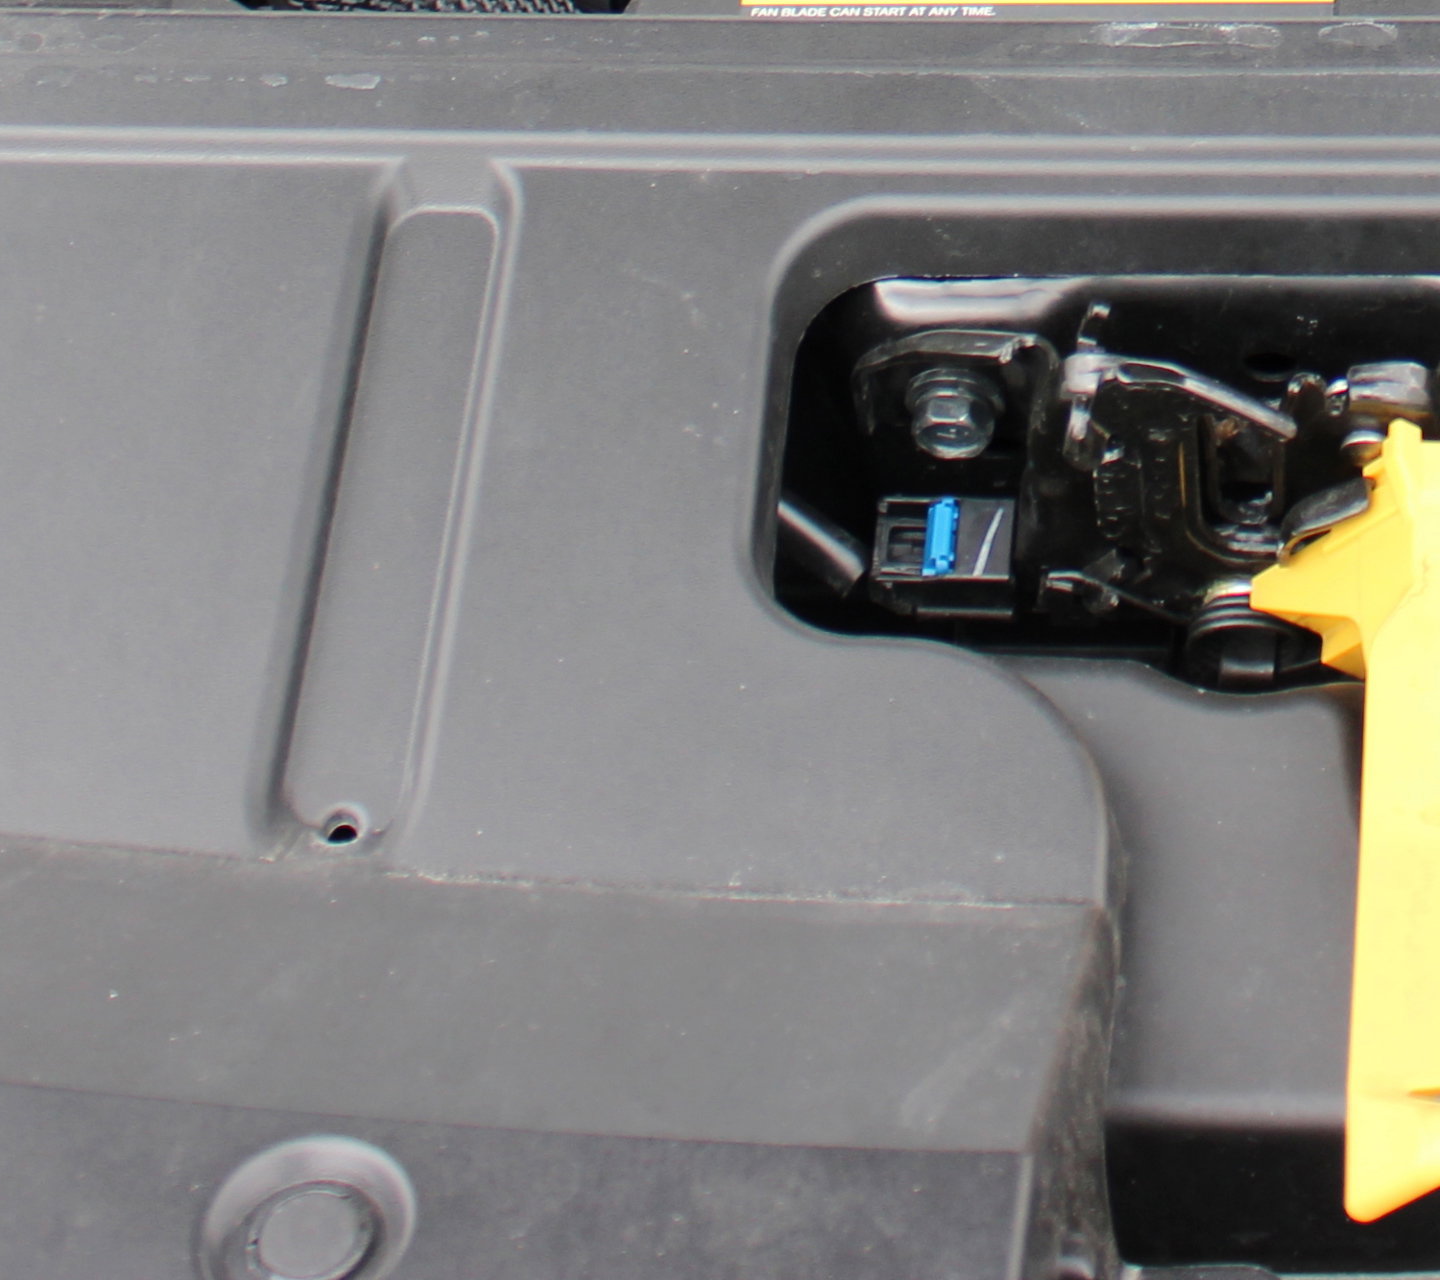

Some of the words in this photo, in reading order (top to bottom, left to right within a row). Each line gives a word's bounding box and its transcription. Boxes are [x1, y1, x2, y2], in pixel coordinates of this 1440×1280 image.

[750, 7, 778, 17] FAN
[780, 7, 828, 17] BLADE
[829, 7, 861, 17] CAN
[863, 7, 907, 17] START
[908, 7, 926, 17] AT
[928, 7, 958, 17] ANY
[960, 6, 997, 17] TIME.
